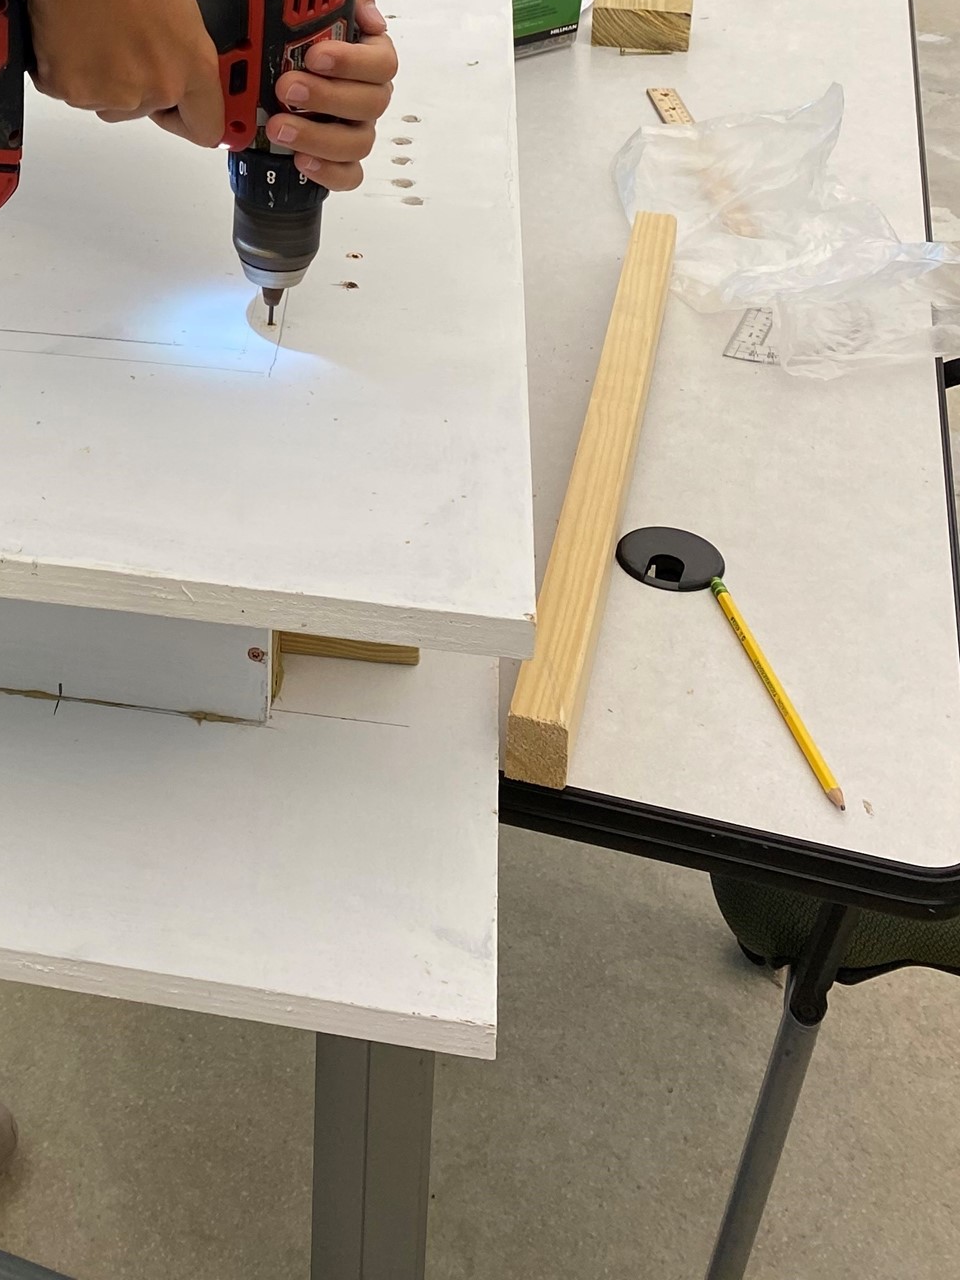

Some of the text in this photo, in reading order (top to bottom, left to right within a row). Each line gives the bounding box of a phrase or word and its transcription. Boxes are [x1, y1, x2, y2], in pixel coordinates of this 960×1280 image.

[550, 24, 577, 35] HILLMAN
[238, 160, 248, 176] 10
[266, 170, 276, 184] 8
